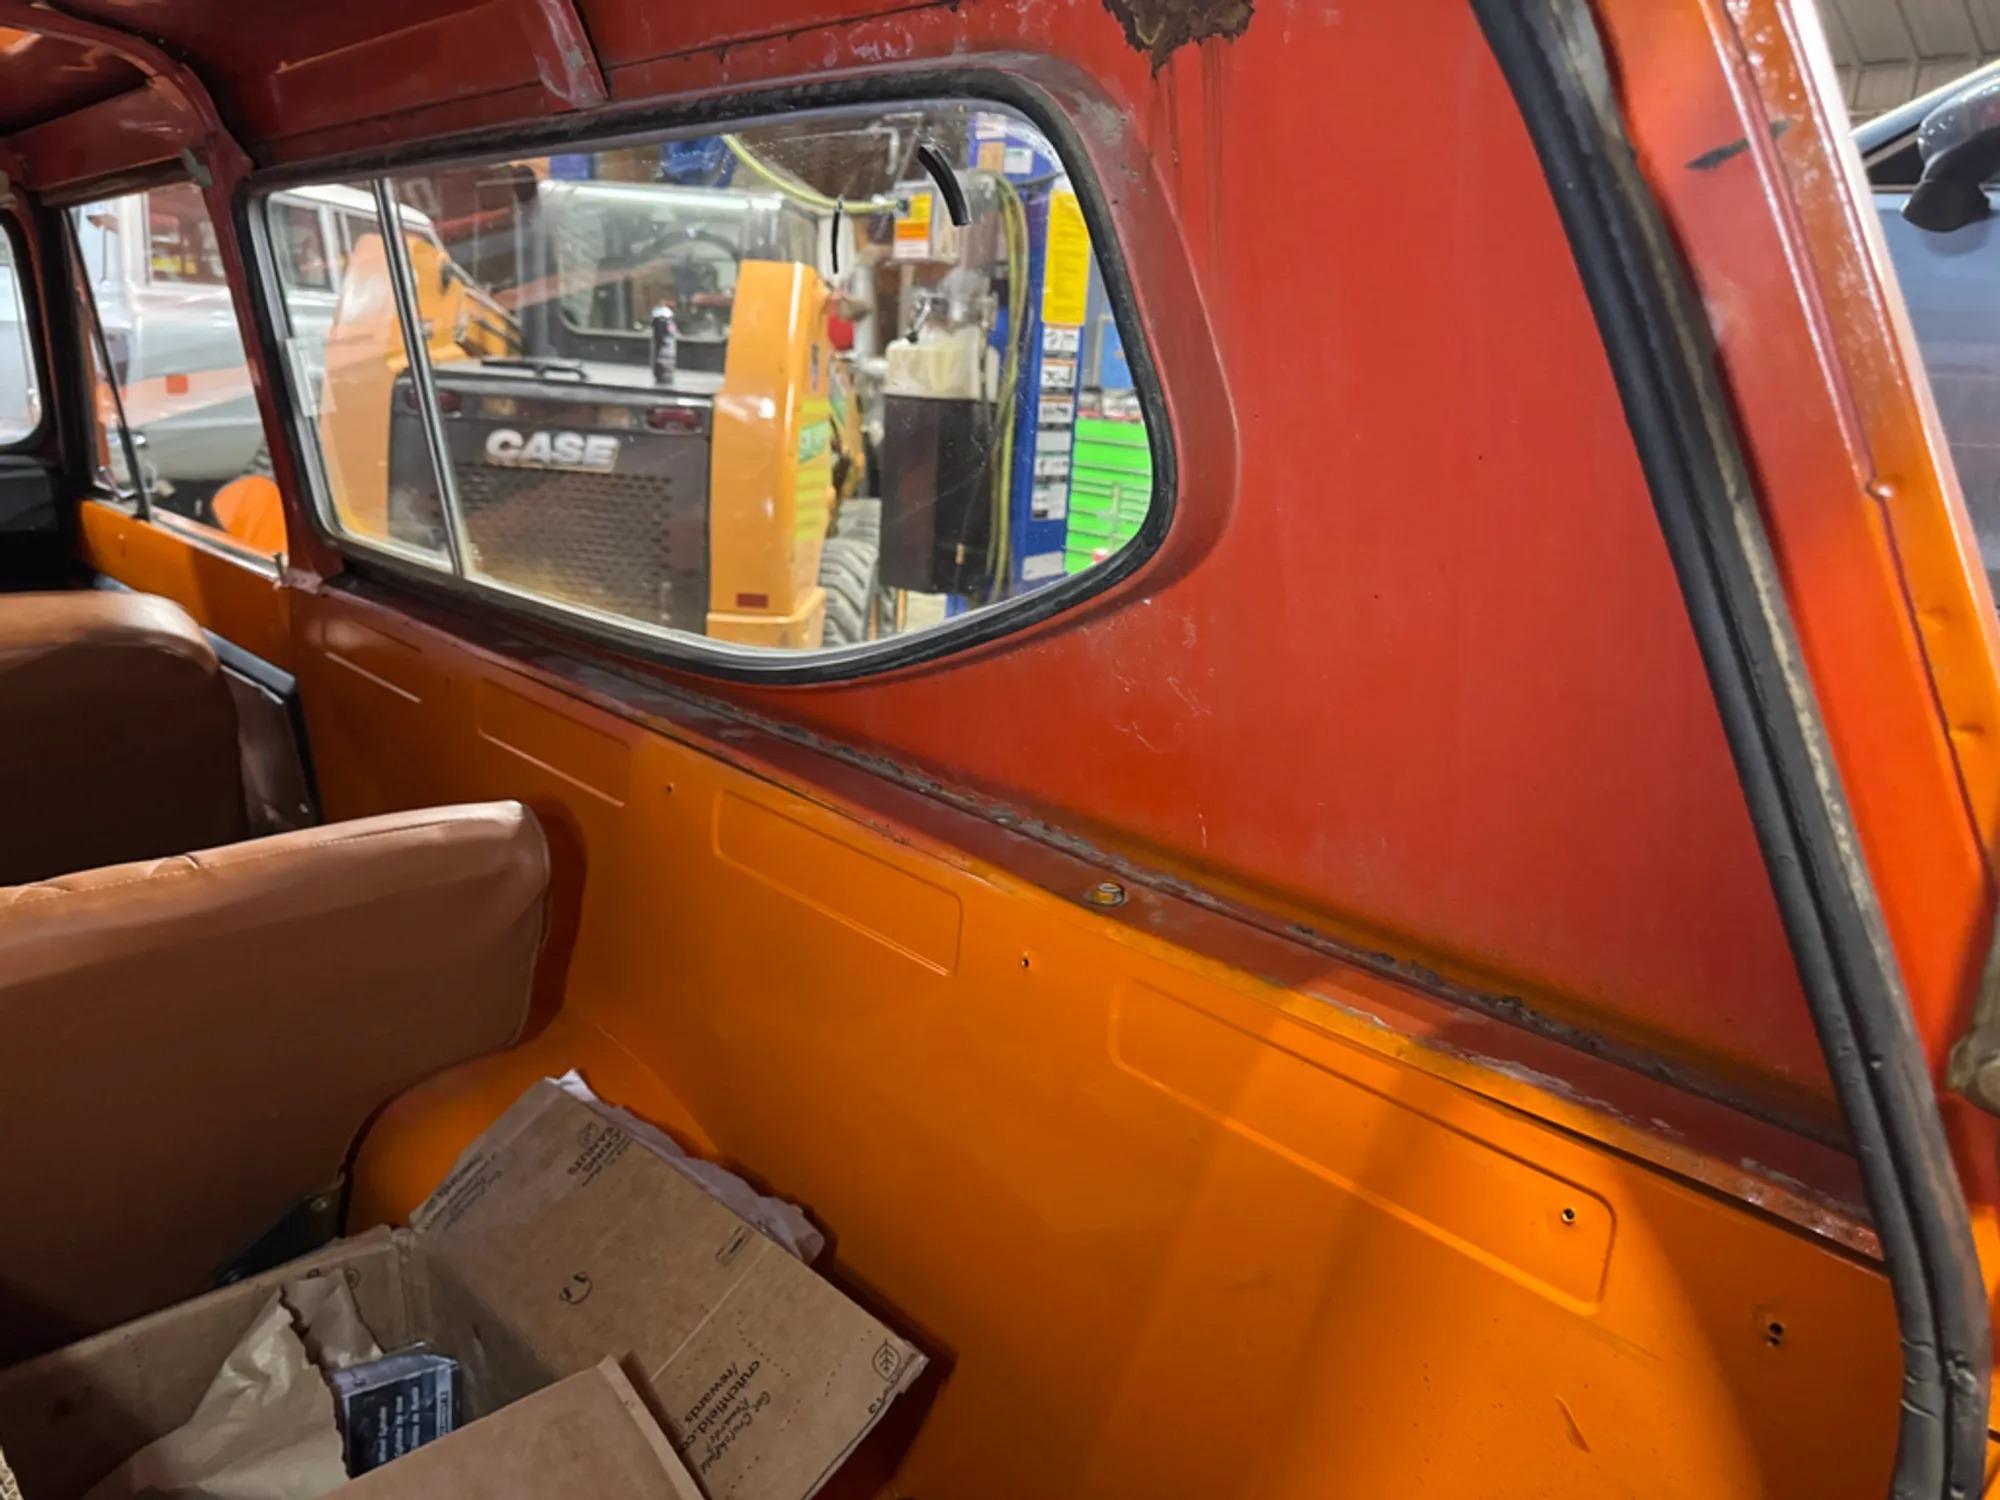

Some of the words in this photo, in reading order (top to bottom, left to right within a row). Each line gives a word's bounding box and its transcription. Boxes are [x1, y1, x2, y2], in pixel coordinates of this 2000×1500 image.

[486, 428, 619, 466] CASE
[680, 1360, 760, 1452] crutchfield.co
[684, 1361, 739, 1424] /rewards
